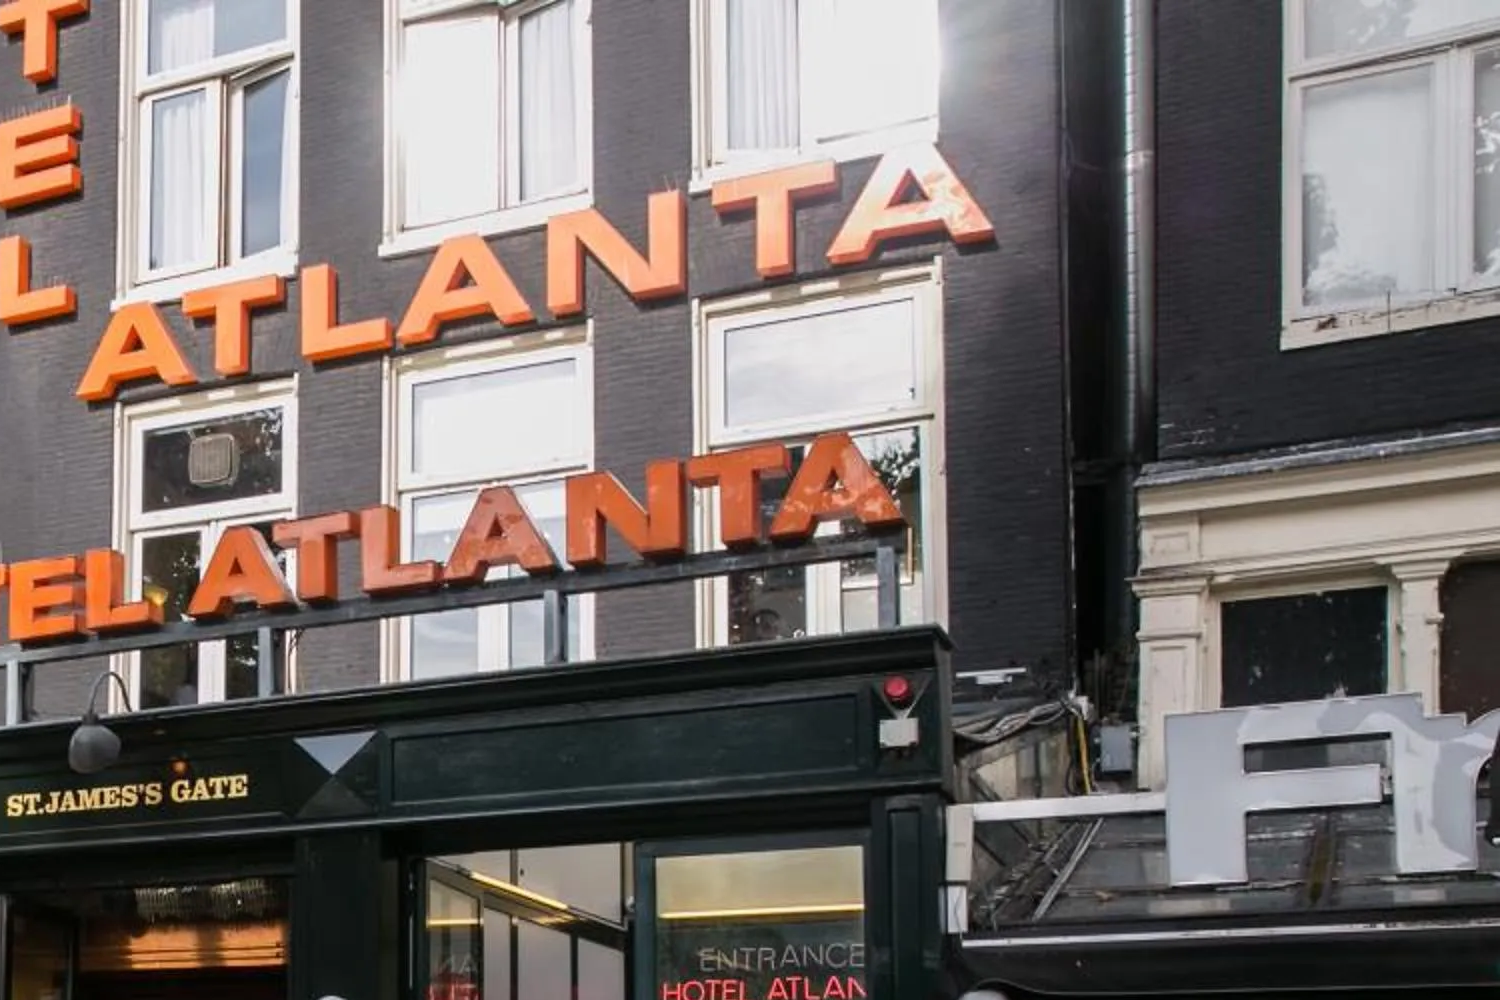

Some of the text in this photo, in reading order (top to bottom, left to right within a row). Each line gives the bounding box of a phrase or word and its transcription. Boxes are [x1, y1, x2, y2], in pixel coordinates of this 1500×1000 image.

[75, 142, 994, 402] ATLANTA
[186, 431, 911, 619] ATLANTA
[7, 774, 249, 817] ST.JAMES'S GATE
[699, 943, 865, 972] ENTRANCE
